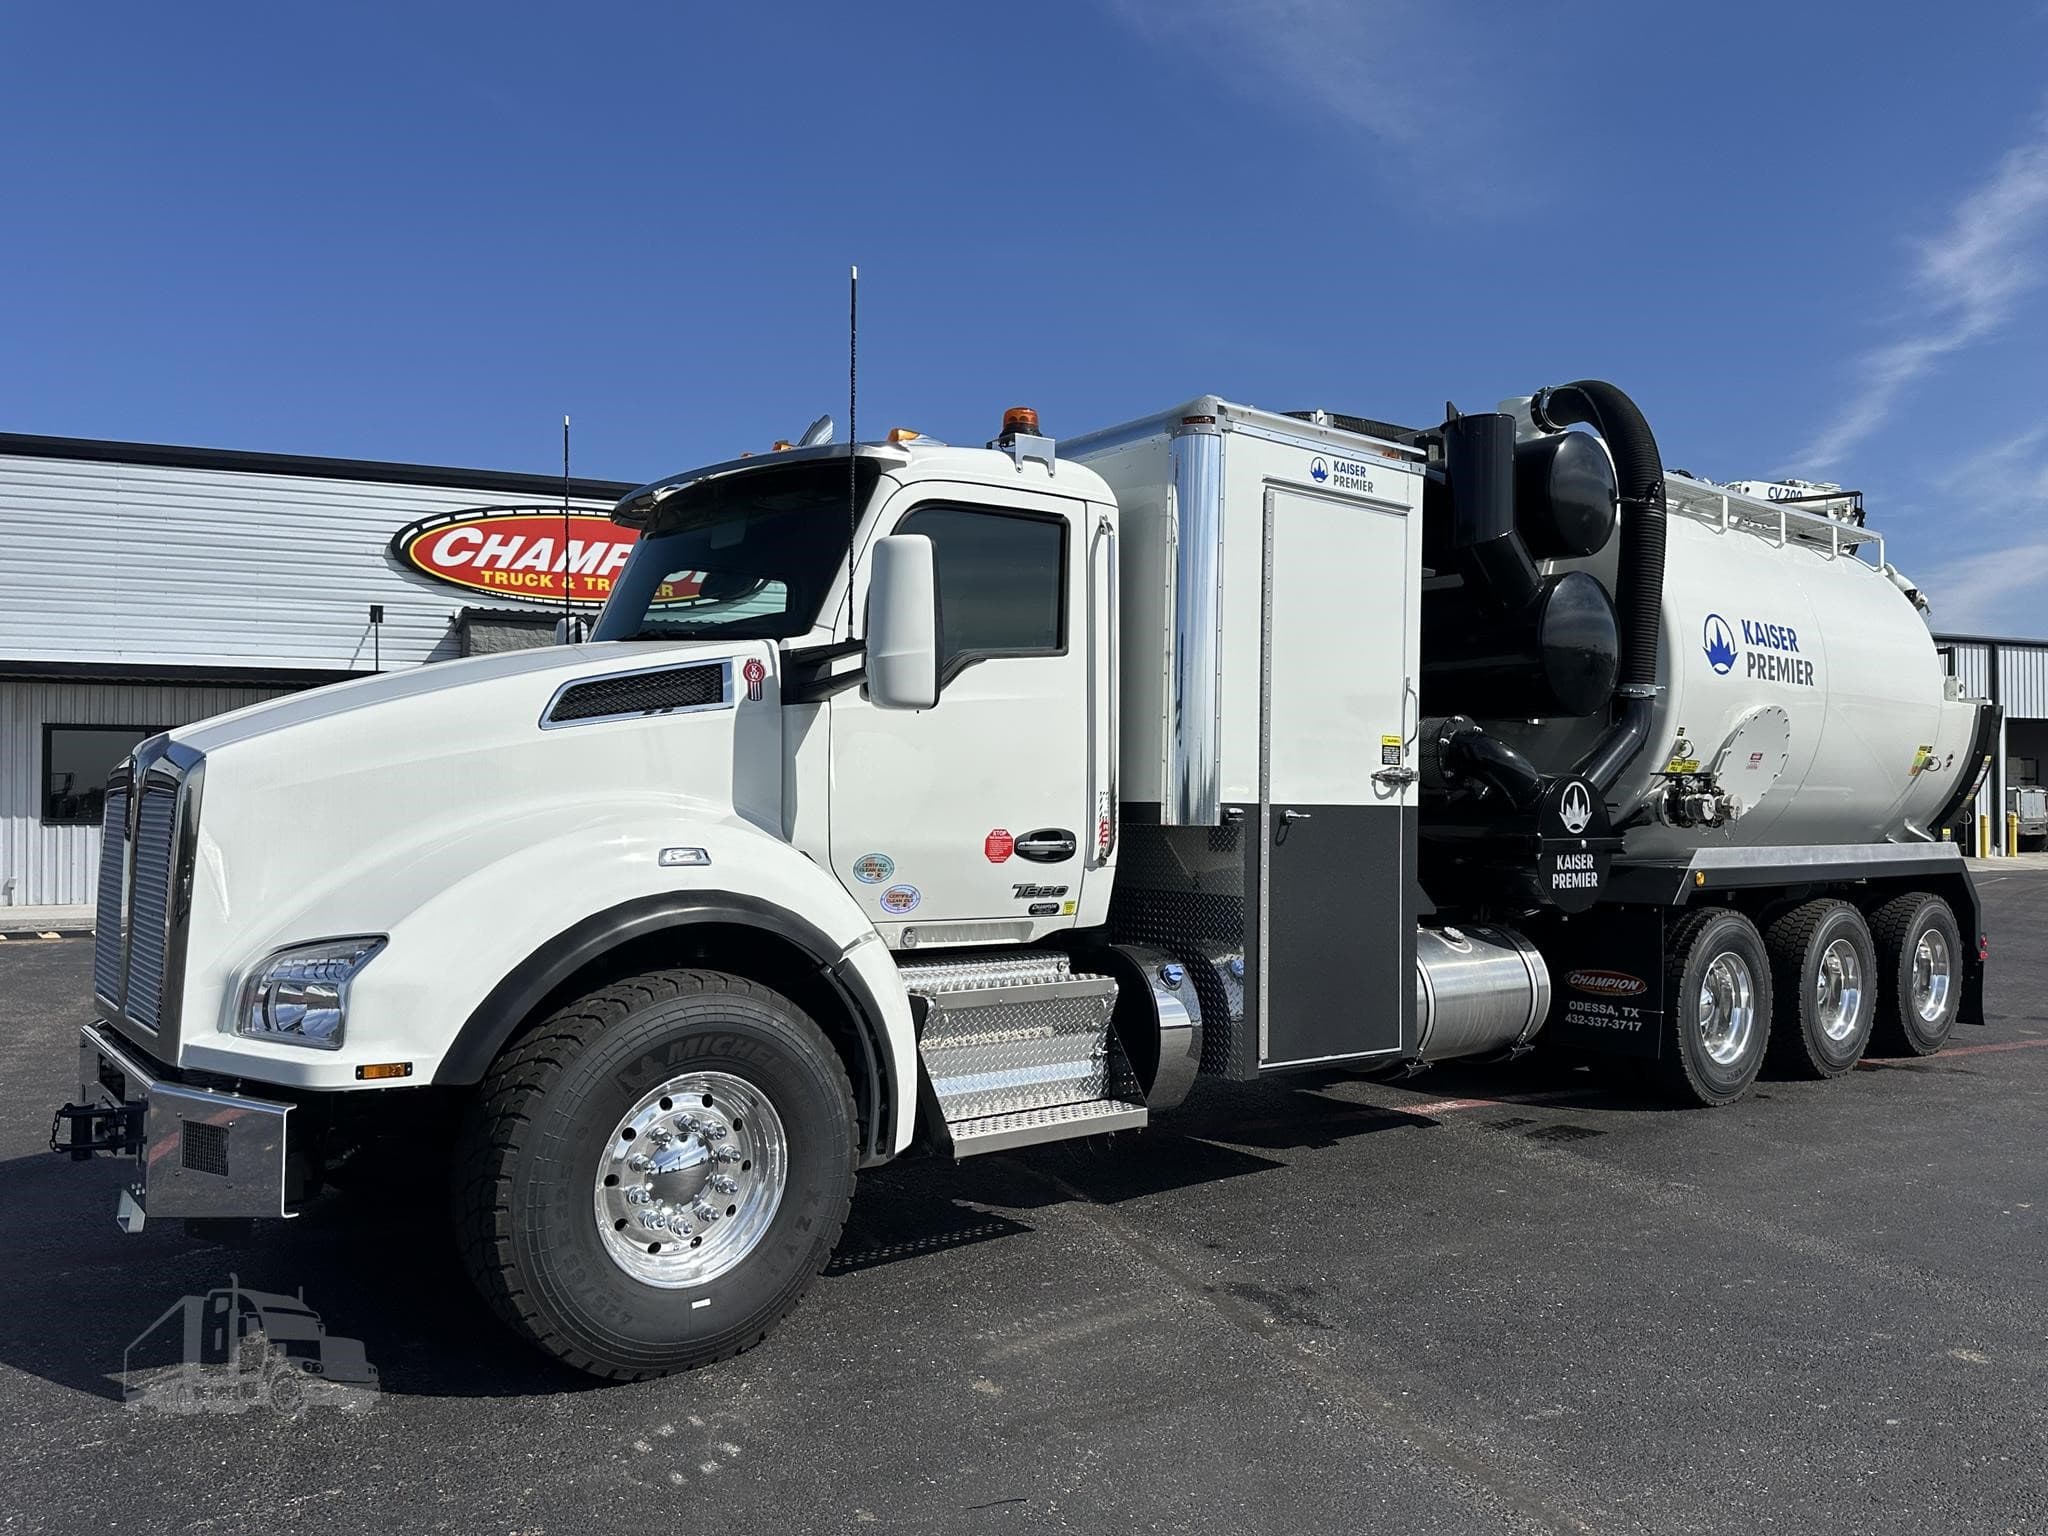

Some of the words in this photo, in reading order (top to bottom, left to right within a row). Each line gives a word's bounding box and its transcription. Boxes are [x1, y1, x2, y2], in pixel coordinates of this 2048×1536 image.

[1333, 460, 1367, 478] KAISER
[1333, 475, 1374, 493] PREMIER
[1768, 486, 1783, 500] CV
[1784, 488, 1802, 500] 200
[481, 570, 553, 589] TRUCK
[561, 575, 577, 589] &
[1741, 619, 1800, 652] KAISER
[1746, 651, 1814, 686] PREMIER
[1556, 854, 1594, 870] KAISER
[1552, 872, 1598, 889] PREMIER
[1569, 973, 1640, 990] CHAMPION
[1568, 1001, 1618, 1018] ODESSA,
[1622, 1006, 1640, 1018] TX
[1565, 1013, 1642, 1031] 432-337-3717
